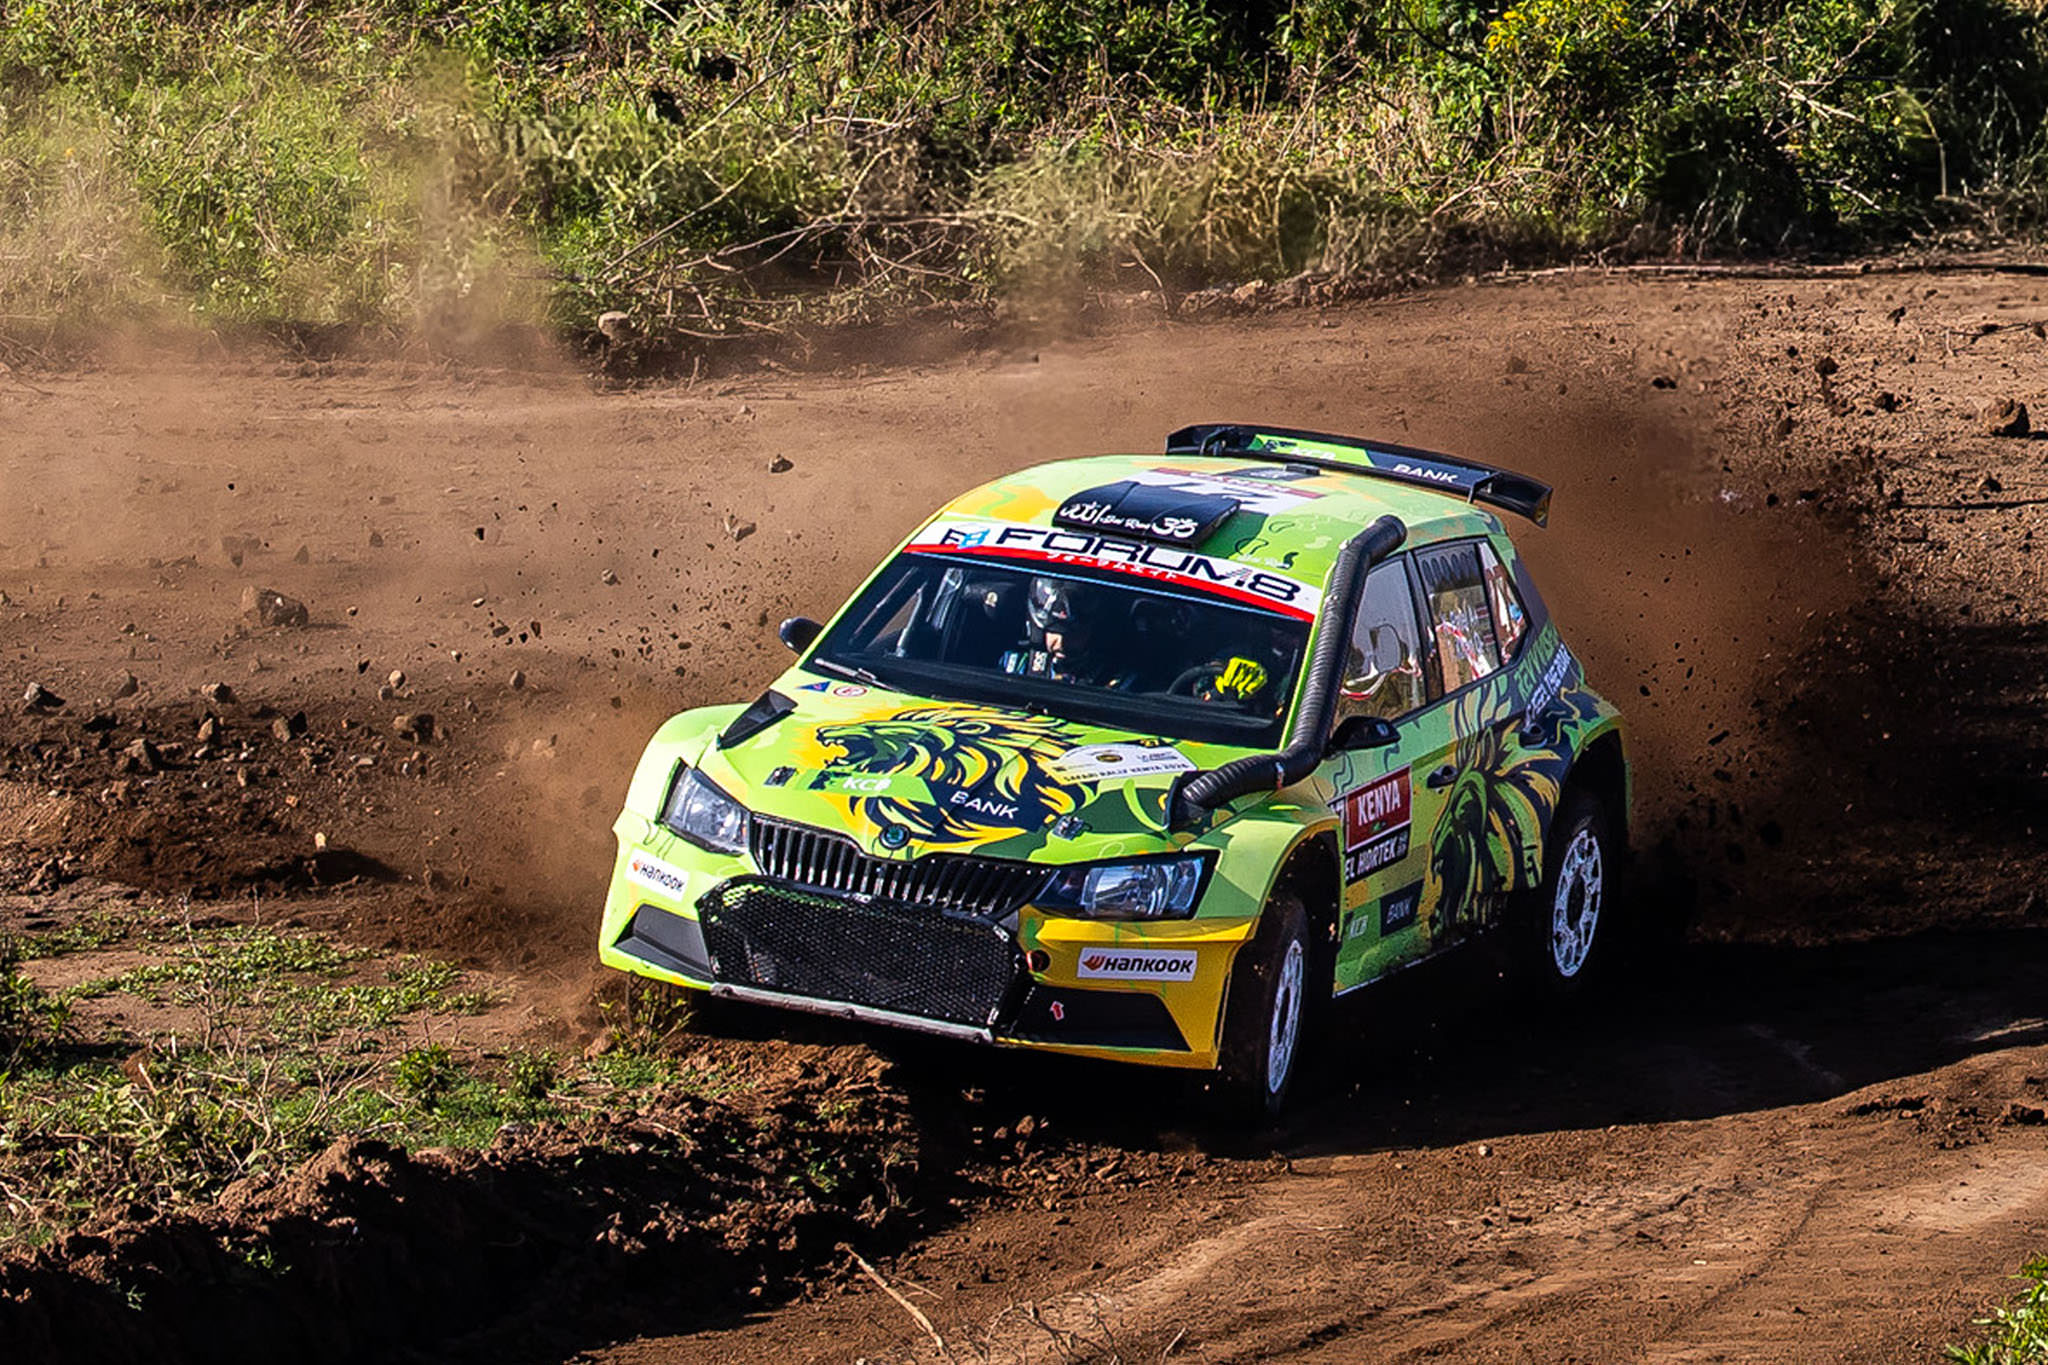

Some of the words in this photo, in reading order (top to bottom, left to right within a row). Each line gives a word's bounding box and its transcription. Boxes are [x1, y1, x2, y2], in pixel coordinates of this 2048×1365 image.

[1392, 463, 1459, 484] BANK
[995, 527, 1302, 602] FORUM8
[950, 790, 1020, 819] BANK
[1357, 779, 1401, 826] KENYA
